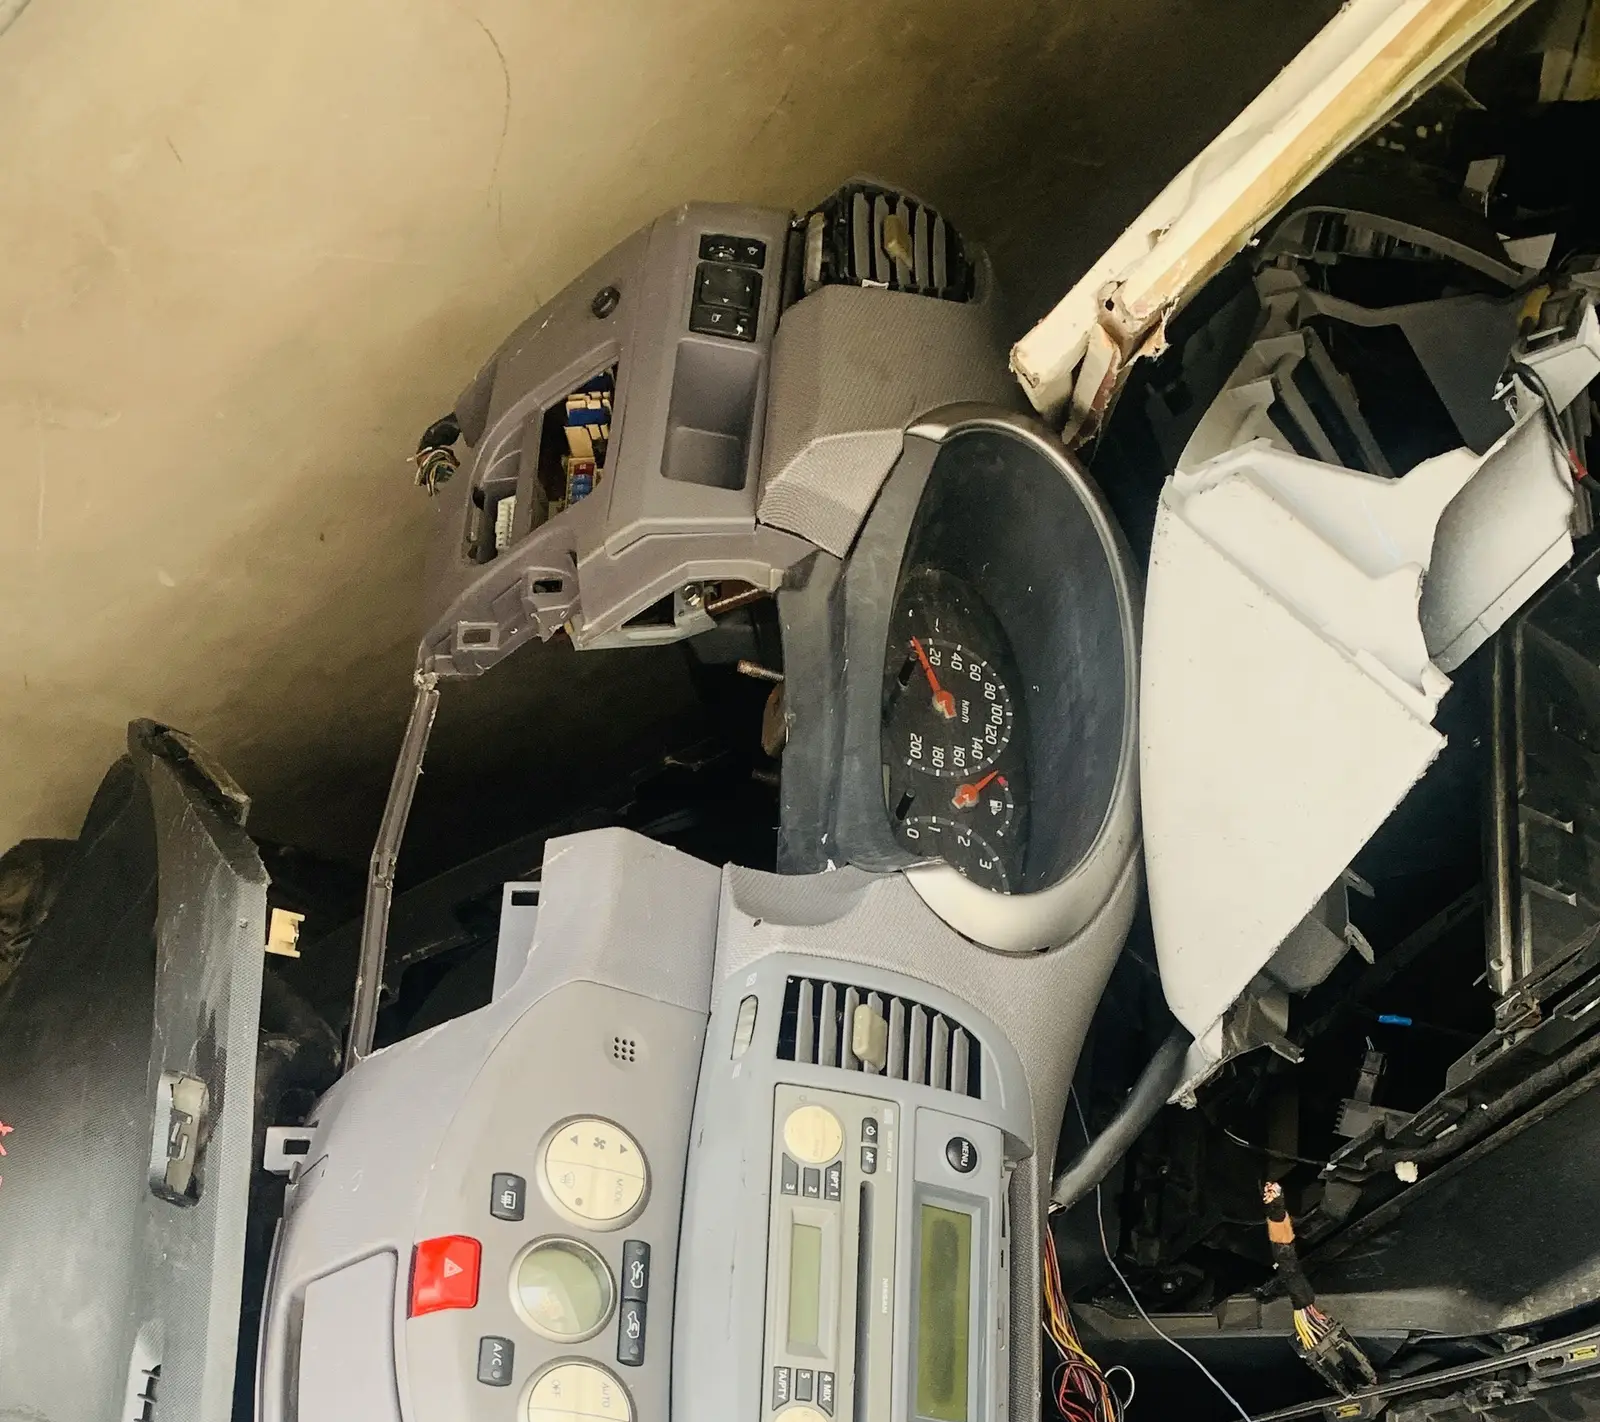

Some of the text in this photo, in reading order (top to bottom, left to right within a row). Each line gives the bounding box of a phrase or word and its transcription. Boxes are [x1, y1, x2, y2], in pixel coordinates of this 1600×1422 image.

[929, 647, 941, 666] 20
[951, 652, 963, 671] 40
[970, 663, 981, 682] 60
[984, 681, 996, 701] 80
[961, 699, 970, 724] km/h
[991, 702, 1003, 725] 100
[985, 723, 997, 745] 120
[910, 732, 922, 759] 200
[932, 745, 944, 768] 180
[953, 745, 965, 767] 160
[971, 736, 983, 760] 140
[906, 828, 920, 839] 0
[957, 835, 971, 847] 2
[979, 858, 992, 870] 3
[866, 1151, 874, 1164] AF
[960, 1140, 970, 1167] MENU
[808, 1185, 817, 1193] 2
[829, 1170, 839, 1189] RPT
[491, 1342, 503, 1366] A/C
[601, 1382, 610, 1408] AUTO
[777, 1368, 788, 1400] TA/PTY
[823, 1374, 832, 1402] 4 MIX
